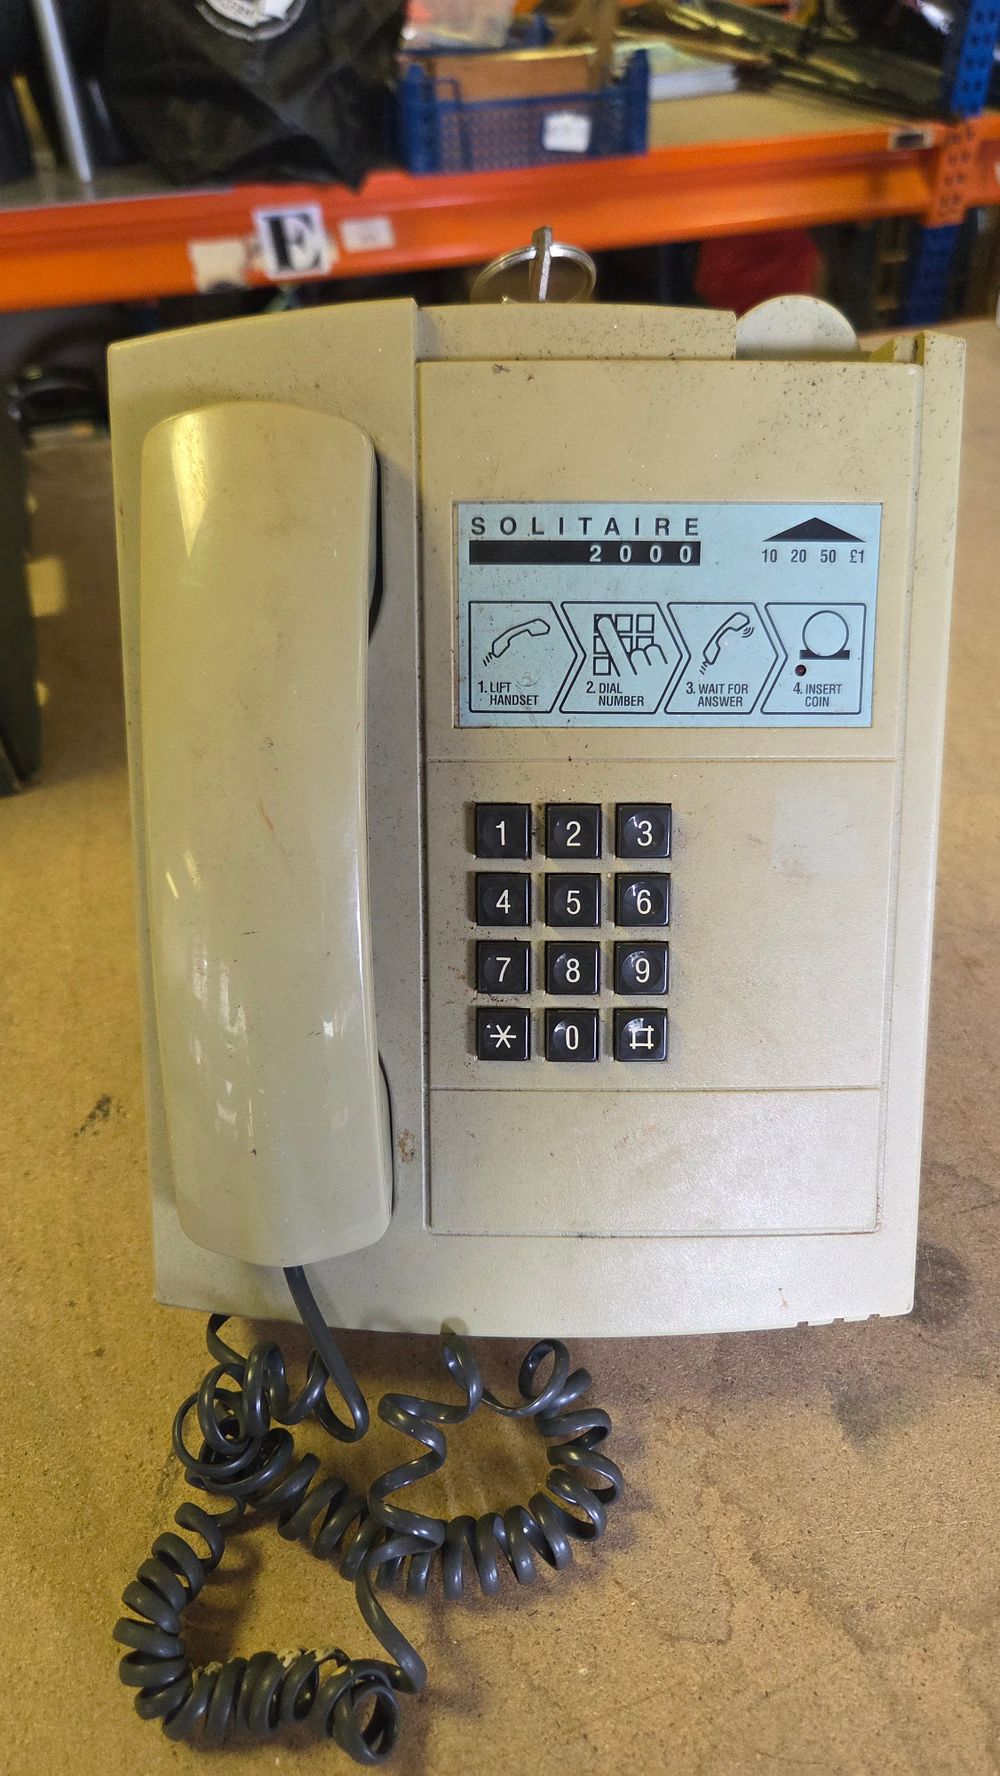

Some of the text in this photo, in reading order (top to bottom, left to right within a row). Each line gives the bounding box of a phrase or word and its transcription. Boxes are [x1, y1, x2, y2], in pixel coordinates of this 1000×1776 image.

[264, 212, 323, 272] E
[471, 516, 699, 536] SOLITAIRE
[589, 544, 693, 564] 2000
[761, 549, 864, 563] 10 20 50 £1
[478, 681, 512, 693] 1. LIFT
[586, 681, 622, 694] 2. DIAL
[686, 681, 748, 695] 3. WAIT FOR
[792, 682, 842, 695] 4. INSERT
[489, 694, 539, 706] HANDSET
[598, 695, 644, 707] NUMBER
[697, 696, 743, 707] ANSWER
[805, 696, 830, 707] COIN
[495, 820, 506, 846] 1
[566, 820, 581, 846] 2
[636, 820, 653, 847] 3
[496, 889, 511, 914] 4
[566, 890, 581, 915] 5
[636, 889, 652, 915] 6
[496, 956, 511, 982] 7
[565, 958, 580, 983] 8
[635, 958, 650, 983] 9
[565, 1025, 579, 1050] 0
